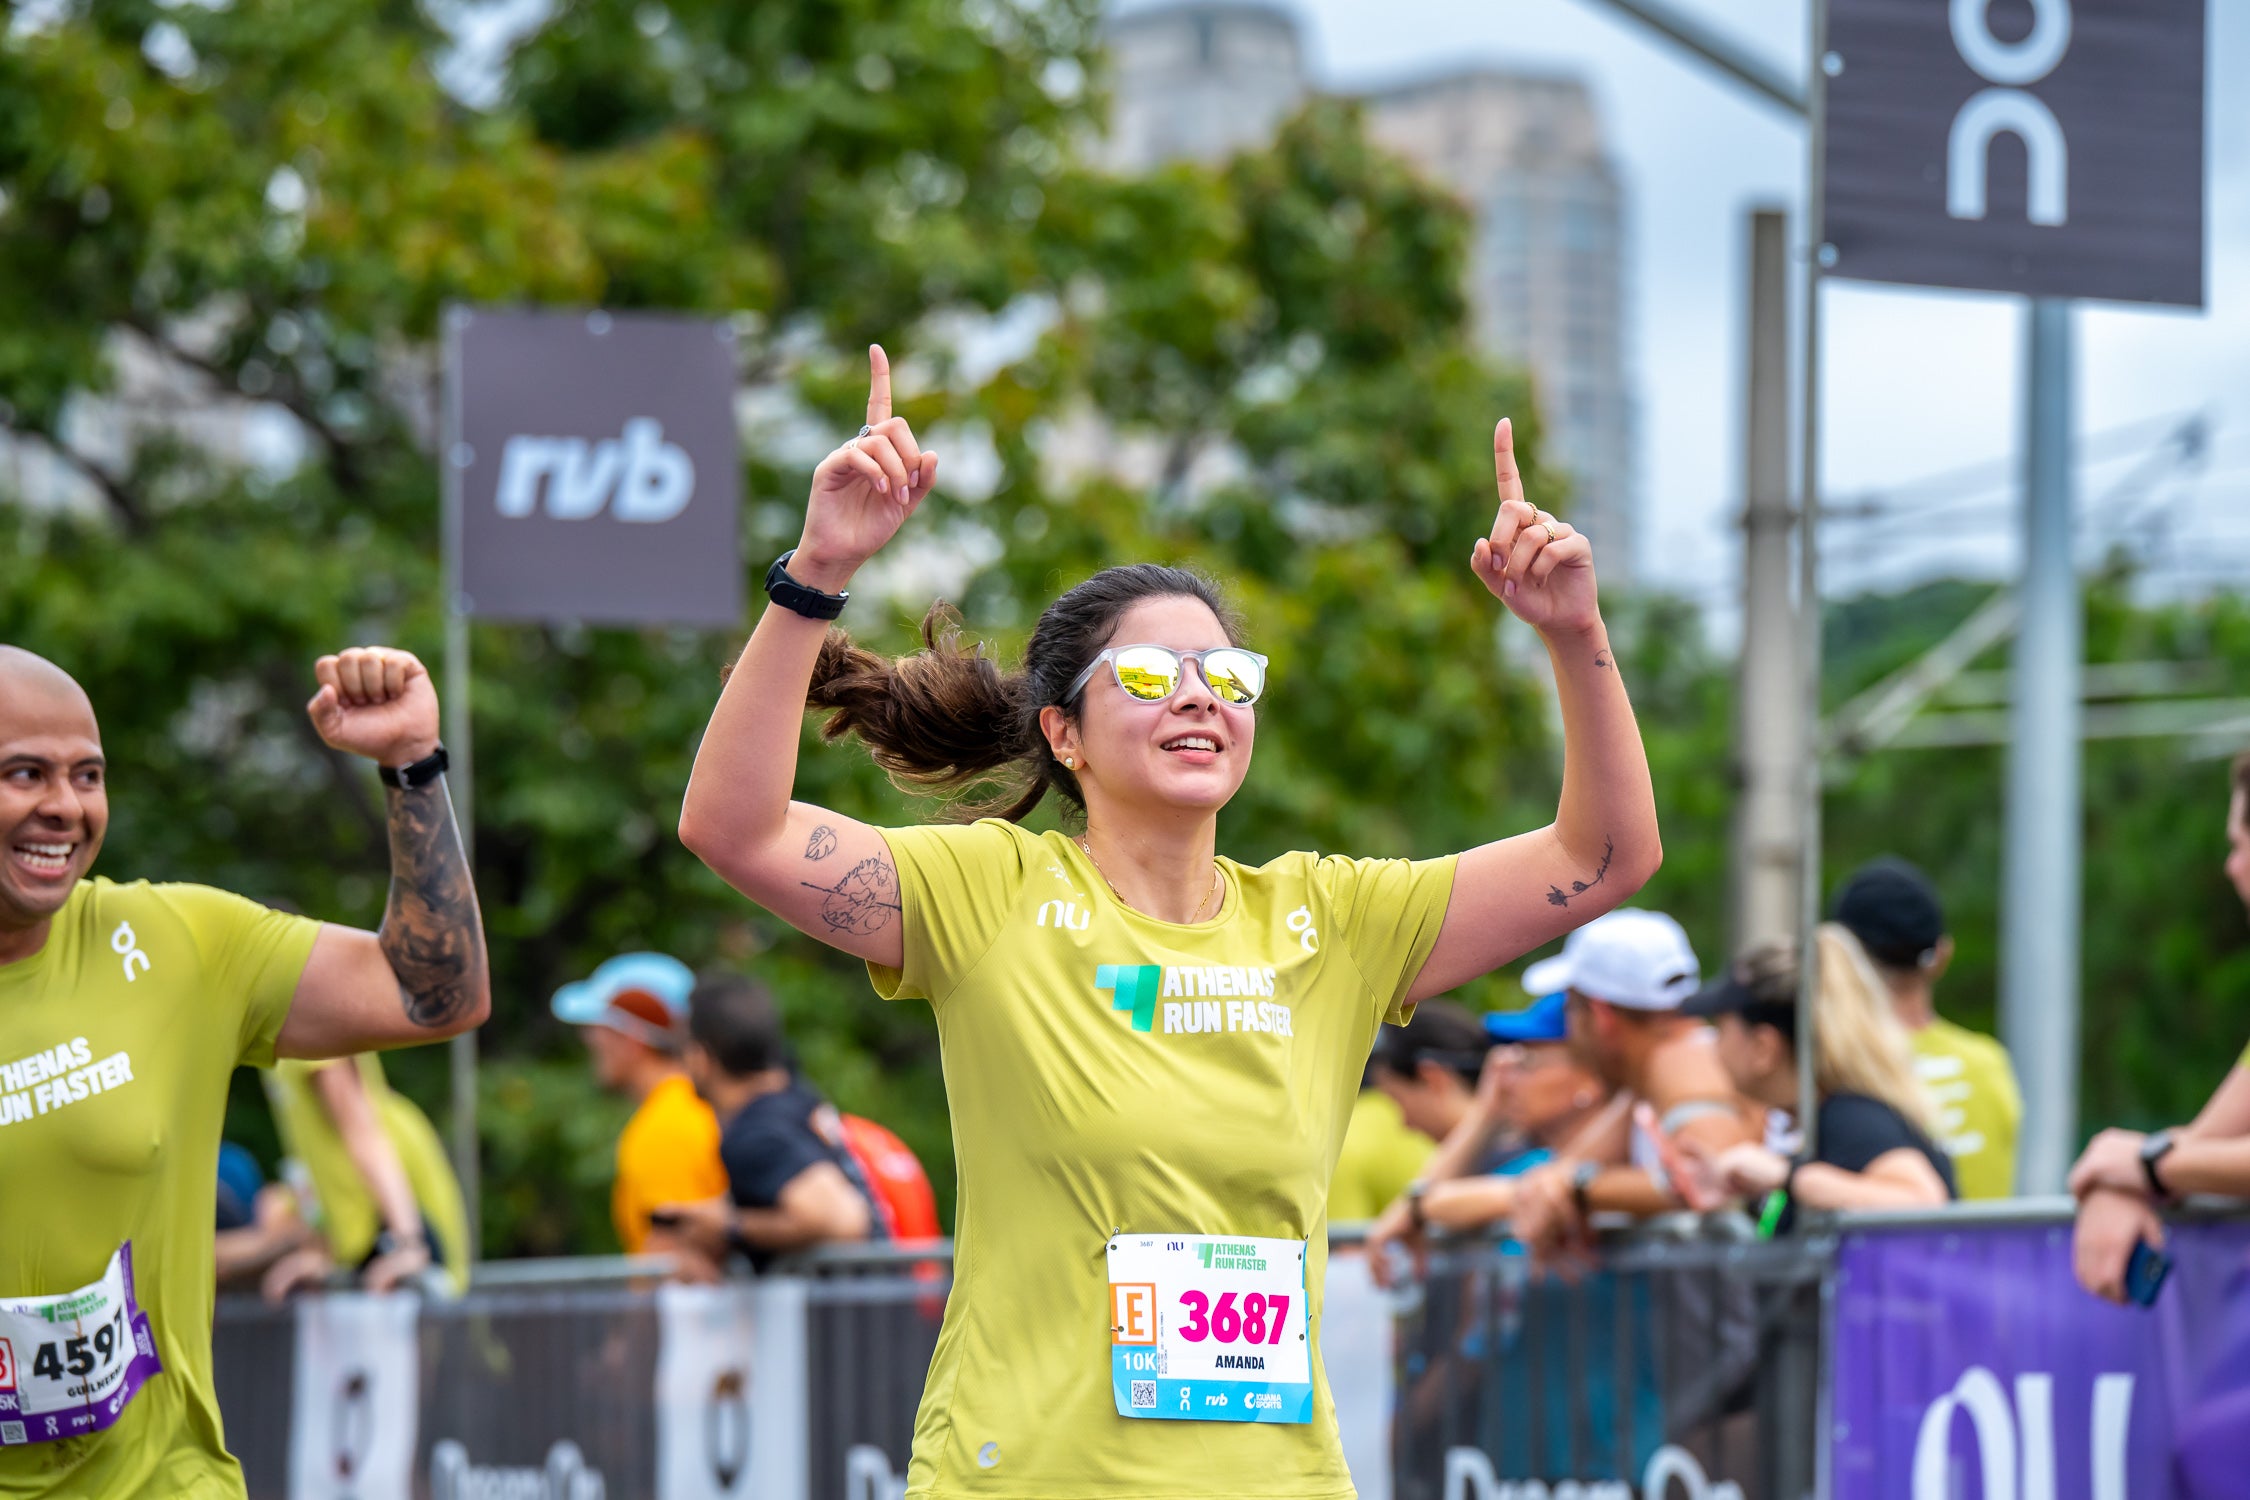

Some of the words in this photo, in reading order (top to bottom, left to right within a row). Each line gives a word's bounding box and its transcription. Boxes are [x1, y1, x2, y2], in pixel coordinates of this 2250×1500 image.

[495, 415, 695, 523] rvb
[1036, 898, 1091, 931] nu
[1163, 965, 1276, 998] ATHENAS
[1163, 1000, 1223, 1035] RUN
[1226, 998, 1294, 1037] FASTER
[34, 1051, 135, 1116] FASTER
[1167, 1241, 1184, 1252] nu
[1215, 1243, 1256, 1257] ATHENAS
[1215, 1258, 1235, 1270] RUN
[1236, 1259, 1267, 1272] FASTER
[1126, 1292, 1145, 1336] E
[1178, 1289, 1290, 1345] 3687
[1123, 1352, 1157, 1371] 10K
[1215, 1354, 1265, 1371] AMANDA
[1256, 1401, 1282, 1410] SPORTS
